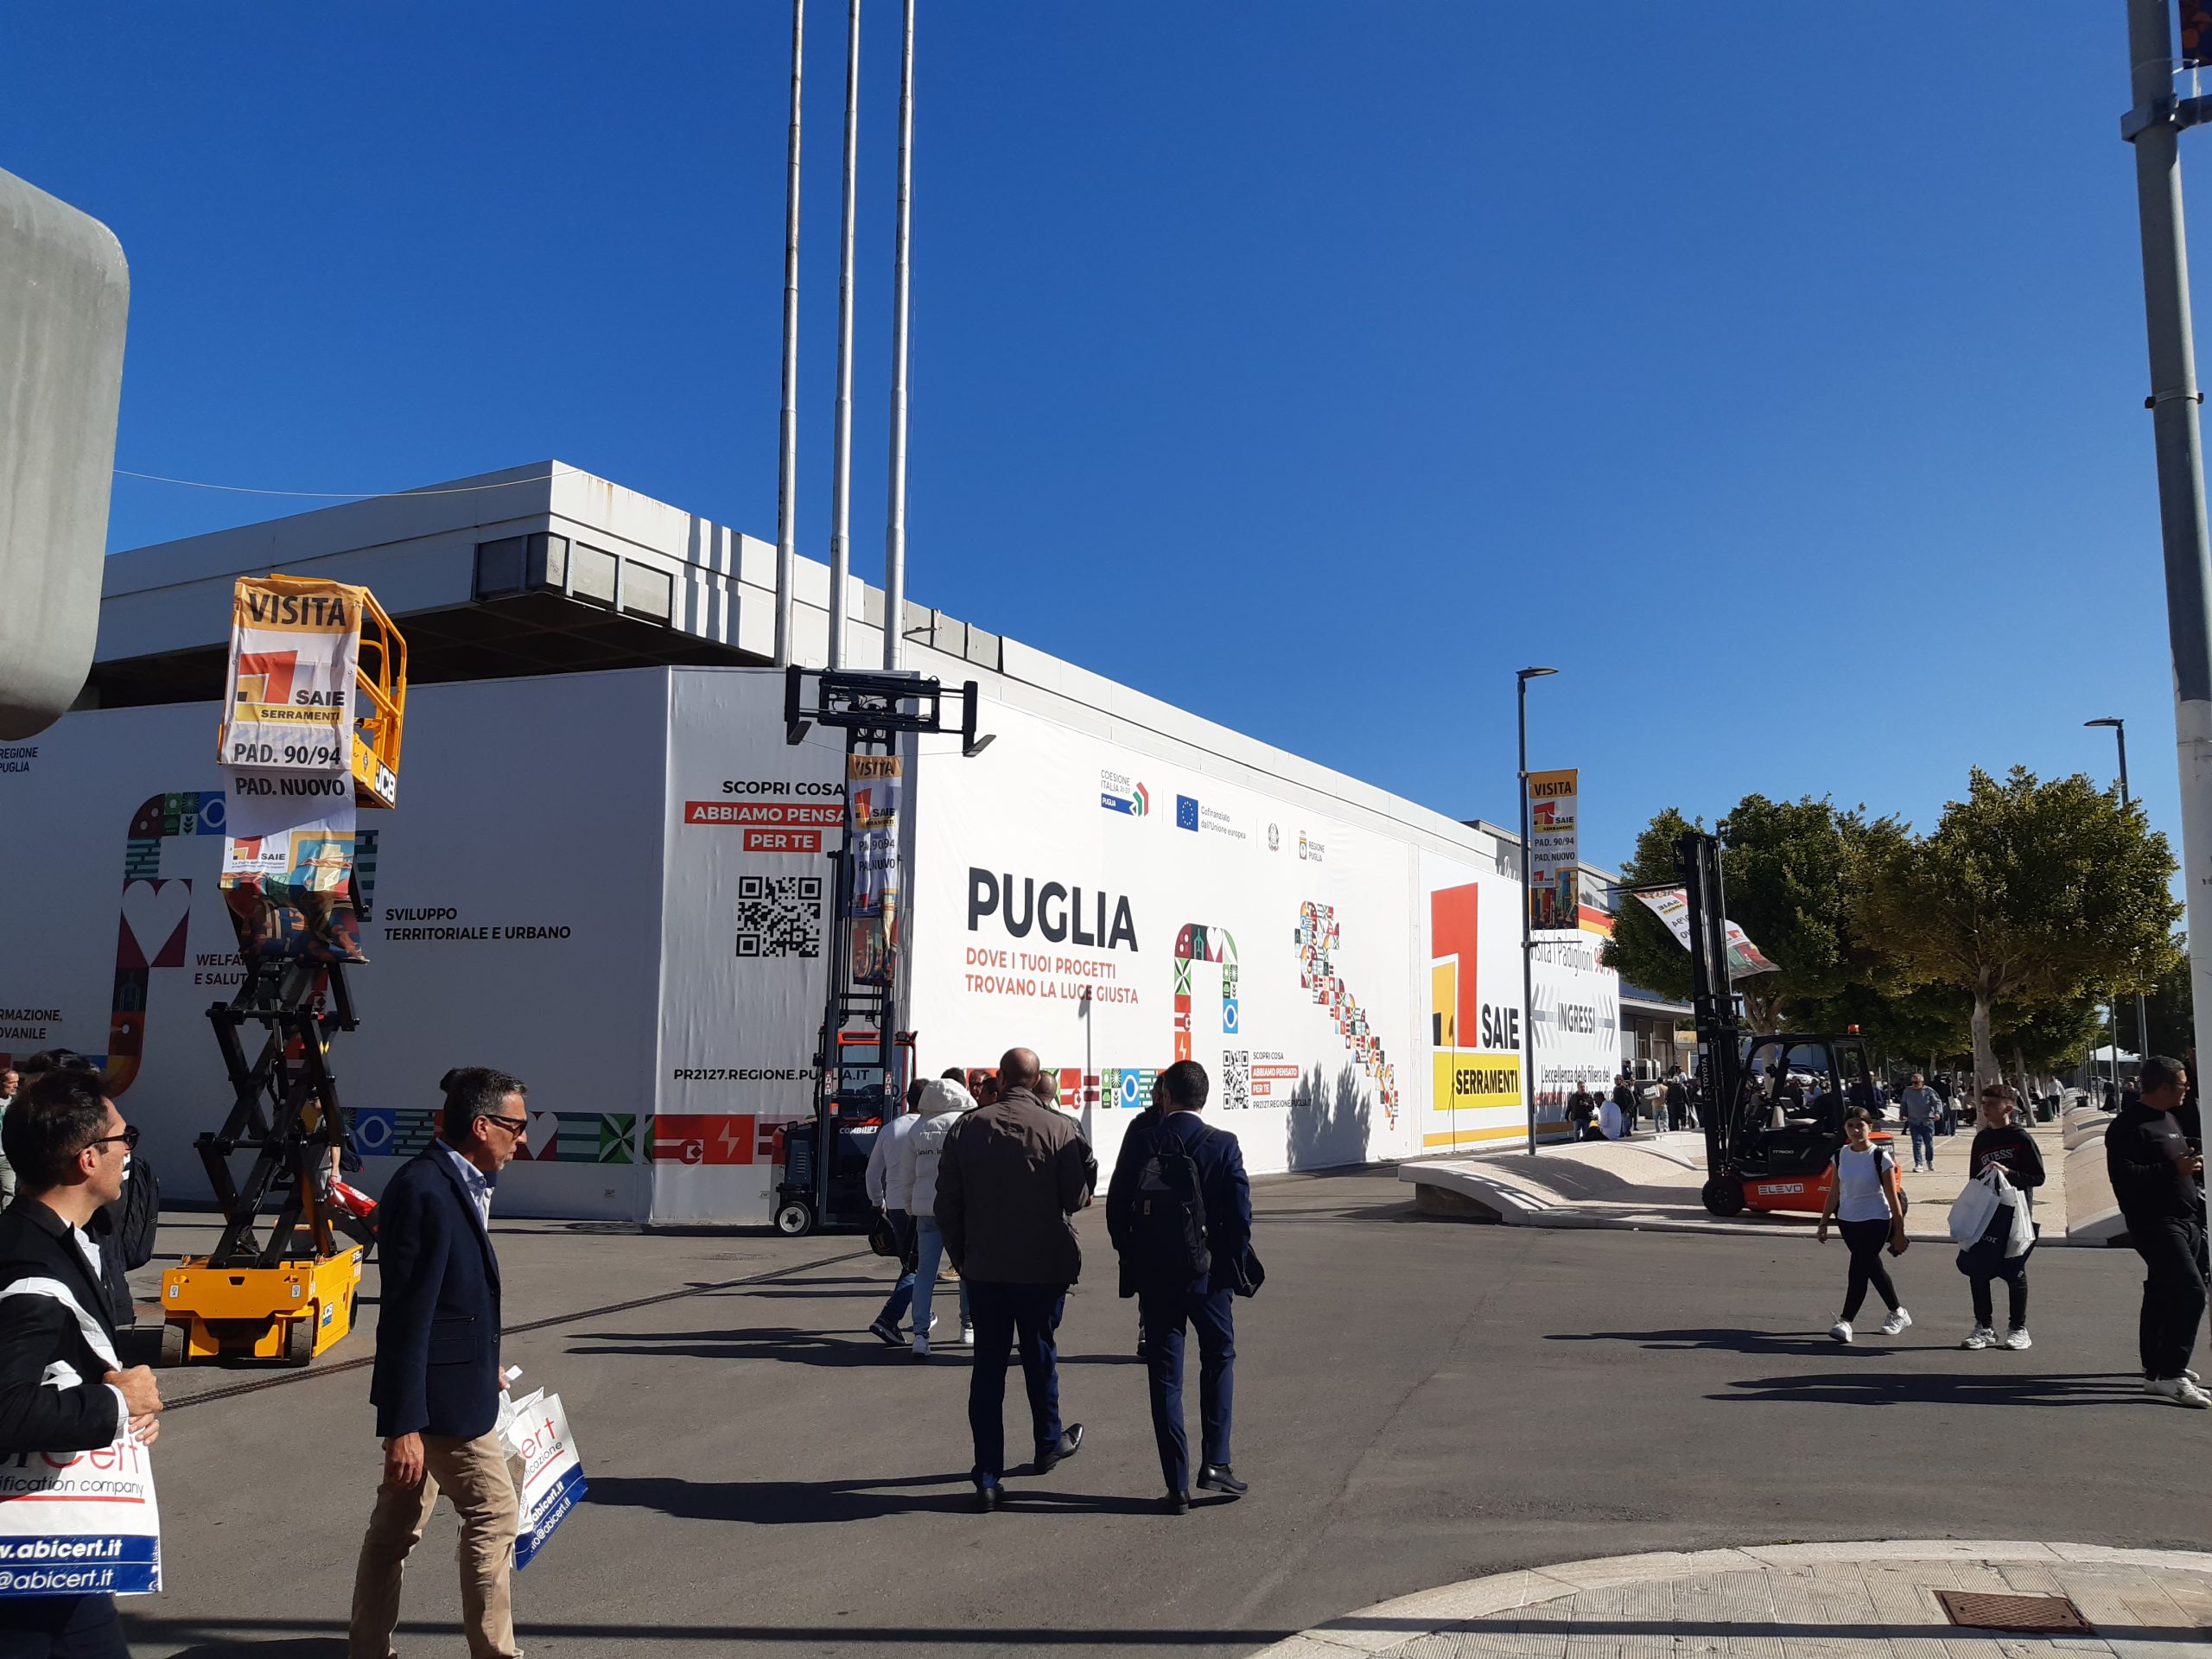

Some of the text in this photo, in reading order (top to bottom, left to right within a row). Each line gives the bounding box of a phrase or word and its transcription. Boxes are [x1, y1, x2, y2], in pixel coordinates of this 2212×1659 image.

[249, 593, 346, 626] VISITA
[295, 690, 345, 706] SAIE
[261, 709, 340, 721] SERRAMENTI
[234, 743, 340, 766] PAD. 90/94
[855, 761, 895, 776] VISITA
[375, 763, 396, 804] JCB
[1101, 769, 1131, 786] COESIONE
[236, 778, 346, 797] PAD. NUOVO
[722, 781, 844, 796] SCOPRI COSA
[1101, 779, 1119, 793] ITALIA
[1535, 781, 1572, 796] VISITA
[1102, 797, 1116, 807] PUGLIA
[692, 806, 782, 822] ABBIAMO
[873, 808, 895, 817] SAIE
[1201, 806, 1230, 823] Cofinanziato
[1201, 820, 1247, 841] dall'Unione europea
[750, 834, 814, 849] PER TE
[1535, 837, 1574, 847] PAD. 90/94
[1535, 852, 1575, 862] PAD. NUOVO
[385, 908, 457, 920] SVILUPPO
[968, 867, 1139, 952] PUGLIA
[385, 926, 571, 940] TERRITORIALE E URBANO
[196, 954, 245, 966] WELFA
[966, 947, 1116, 979] DOVE I TUOI PROGETTI
[1558, 937, 1593, 976] Padiglioni
[194, 973, 203, 985] E
[965, 974, 1139, 1004] TROVANO LA LUCE GIUSTA
[1558, 1002, 1595, 1034] INGRESSI
[1482, 1003, 1519, 1049] SAIE
[1253, 1052, 1271, 1060] SCOPRI
[1252, 1067, 1298, 1077] ABBIAMO PENSATO
[1541, 1065, 1573, 1084] L'eccellenza
[1574, 1065, 1587, 1083] della
[1587, 1065, 1602, 1083] filiera
[1253, 1084, 1270, 1093] PER TE
[1456, 1069, 1518, 1095] SERRAMENTI
[1759, 1185, 1803, 1195] ELEVO
[80, 1479, 144, 1496] company
